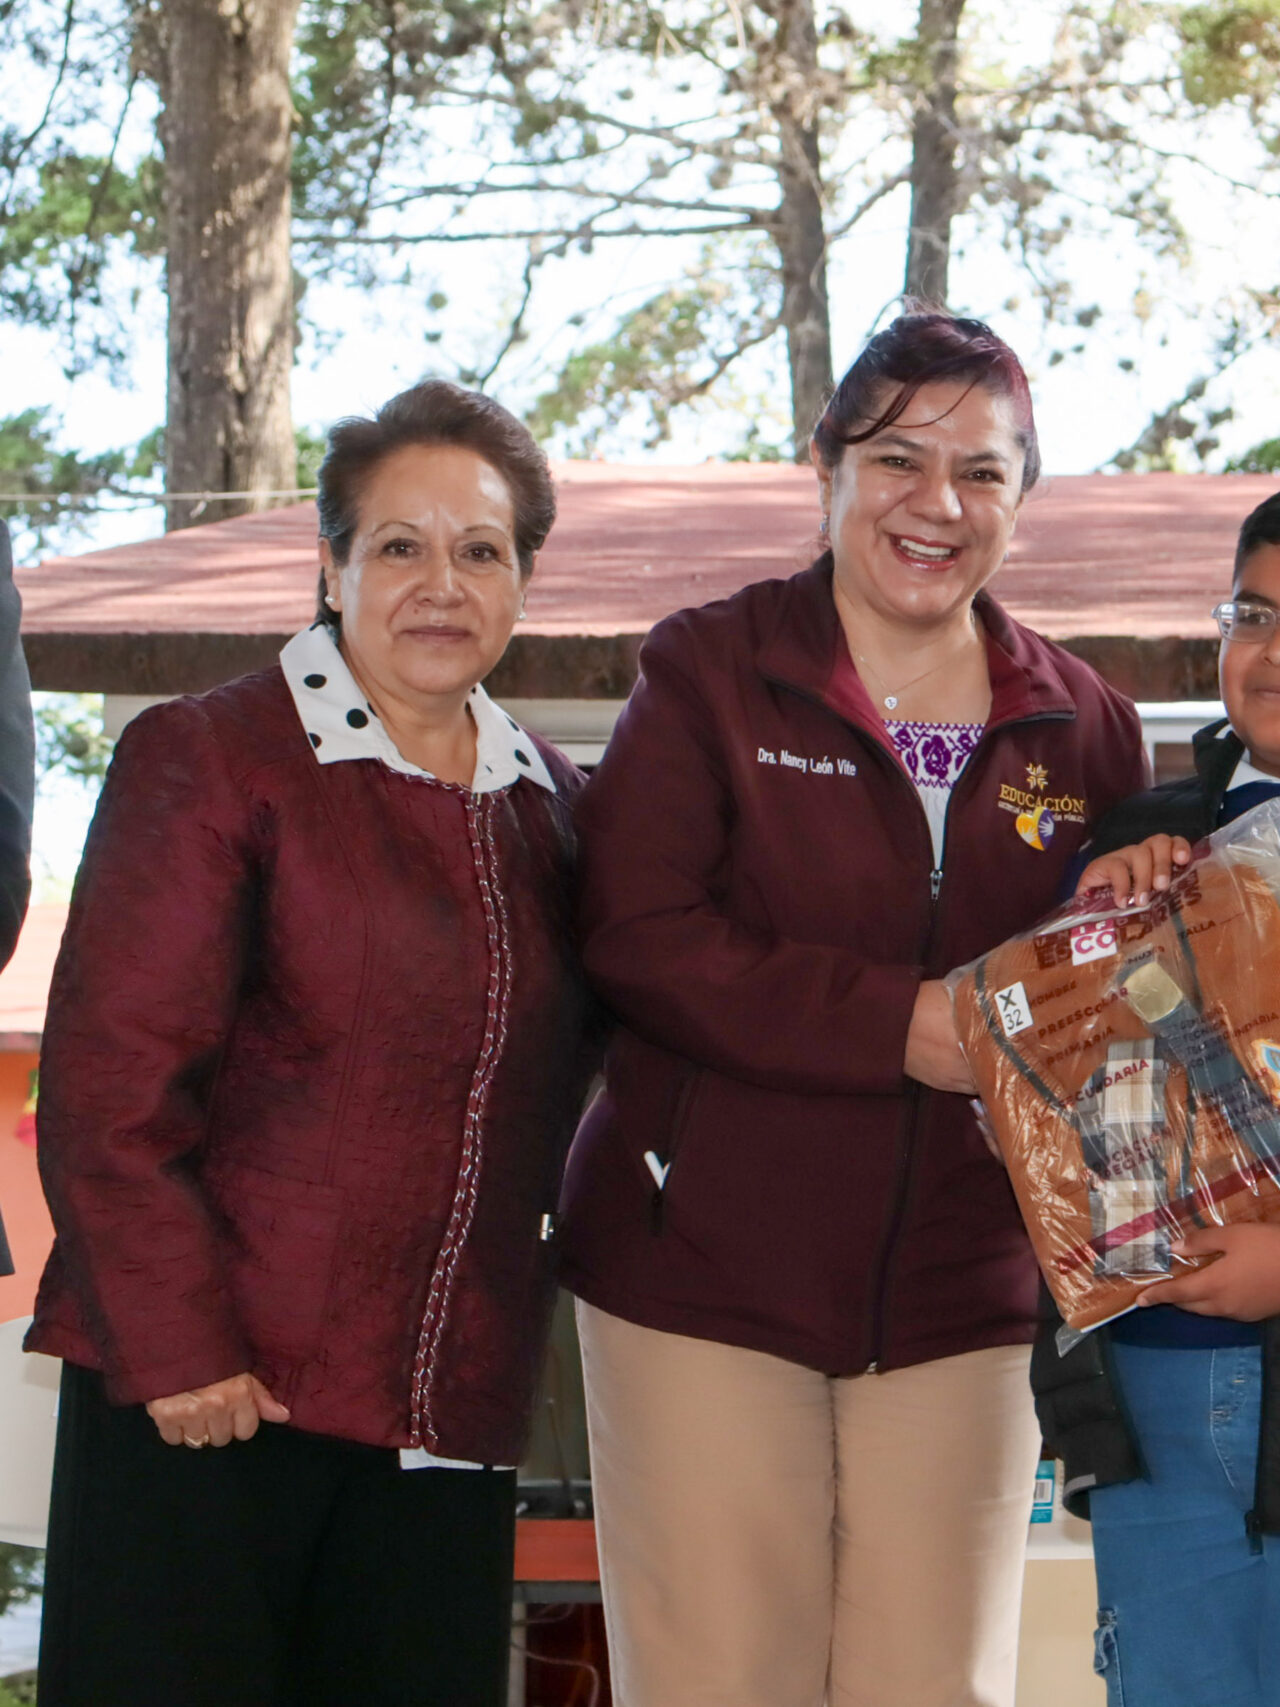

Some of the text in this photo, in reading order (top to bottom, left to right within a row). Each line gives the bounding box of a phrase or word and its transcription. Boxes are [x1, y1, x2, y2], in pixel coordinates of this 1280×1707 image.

[757, 747, 857, 776] Dra. Nancy León Vite
[999, 783, 1086, 813] EDUCACIÓN
[1180, 919, 1216, 939] TALLA
[1005, 1008, 1023, 1030] 32
[1038, 987, 1128, 1039] PREESCOLAR
[1046, 1025, 1115, 1066] PRIMARIA
[1057, 1058, 1149, 1108] SECUNDARIA
[1084, 1126, 1172, 1180] DUCACIÓN
